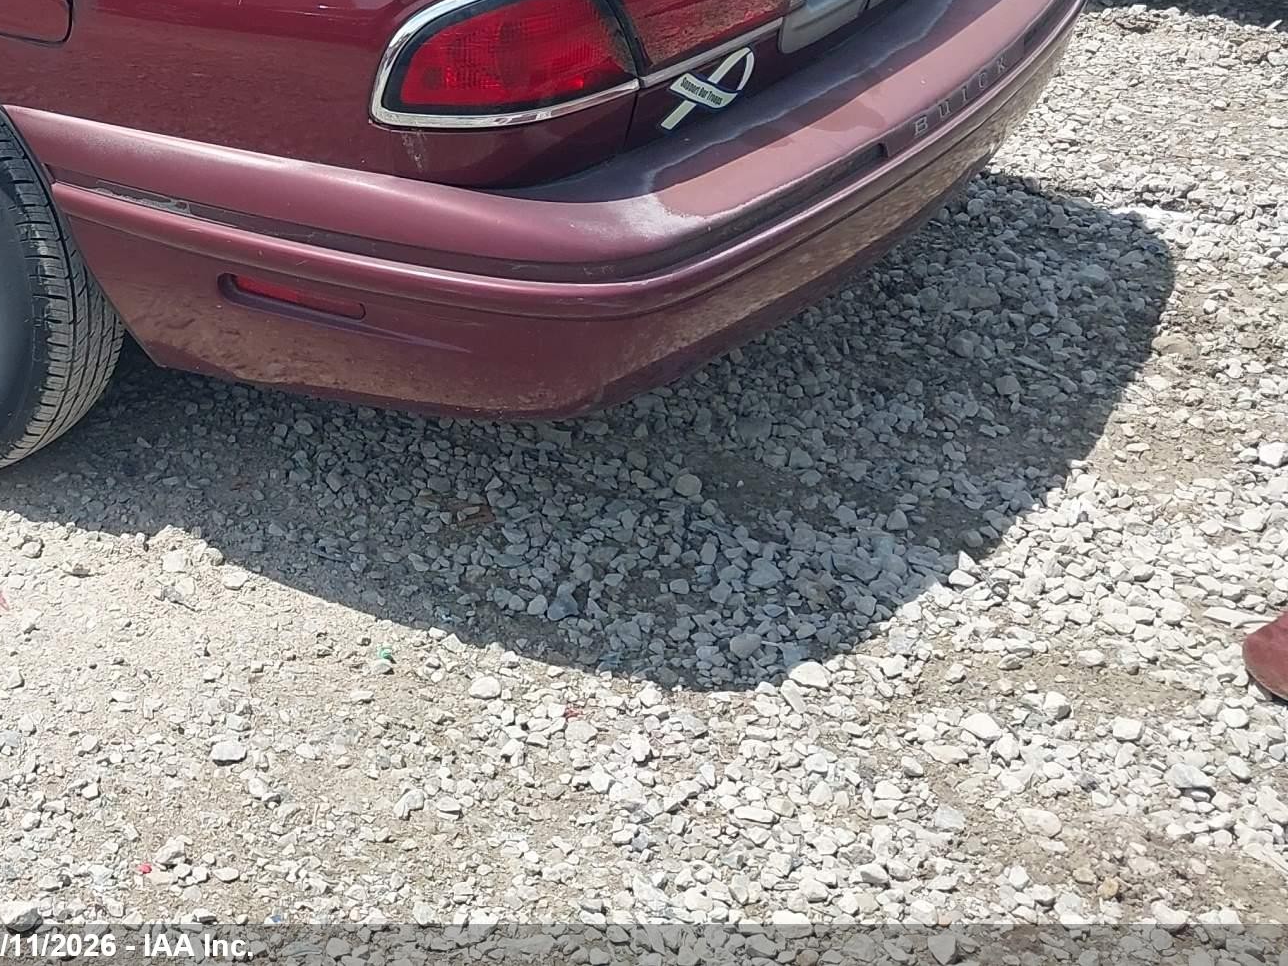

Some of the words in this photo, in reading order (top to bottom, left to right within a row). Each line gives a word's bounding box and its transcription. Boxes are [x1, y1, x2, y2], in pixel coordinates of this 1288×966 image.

[680, 76, 701, 95] Support
[697, 86, 709, 99] Our
[706, 90, 723, 106] Troops
[912, 56, 1006, 136] BUICK
